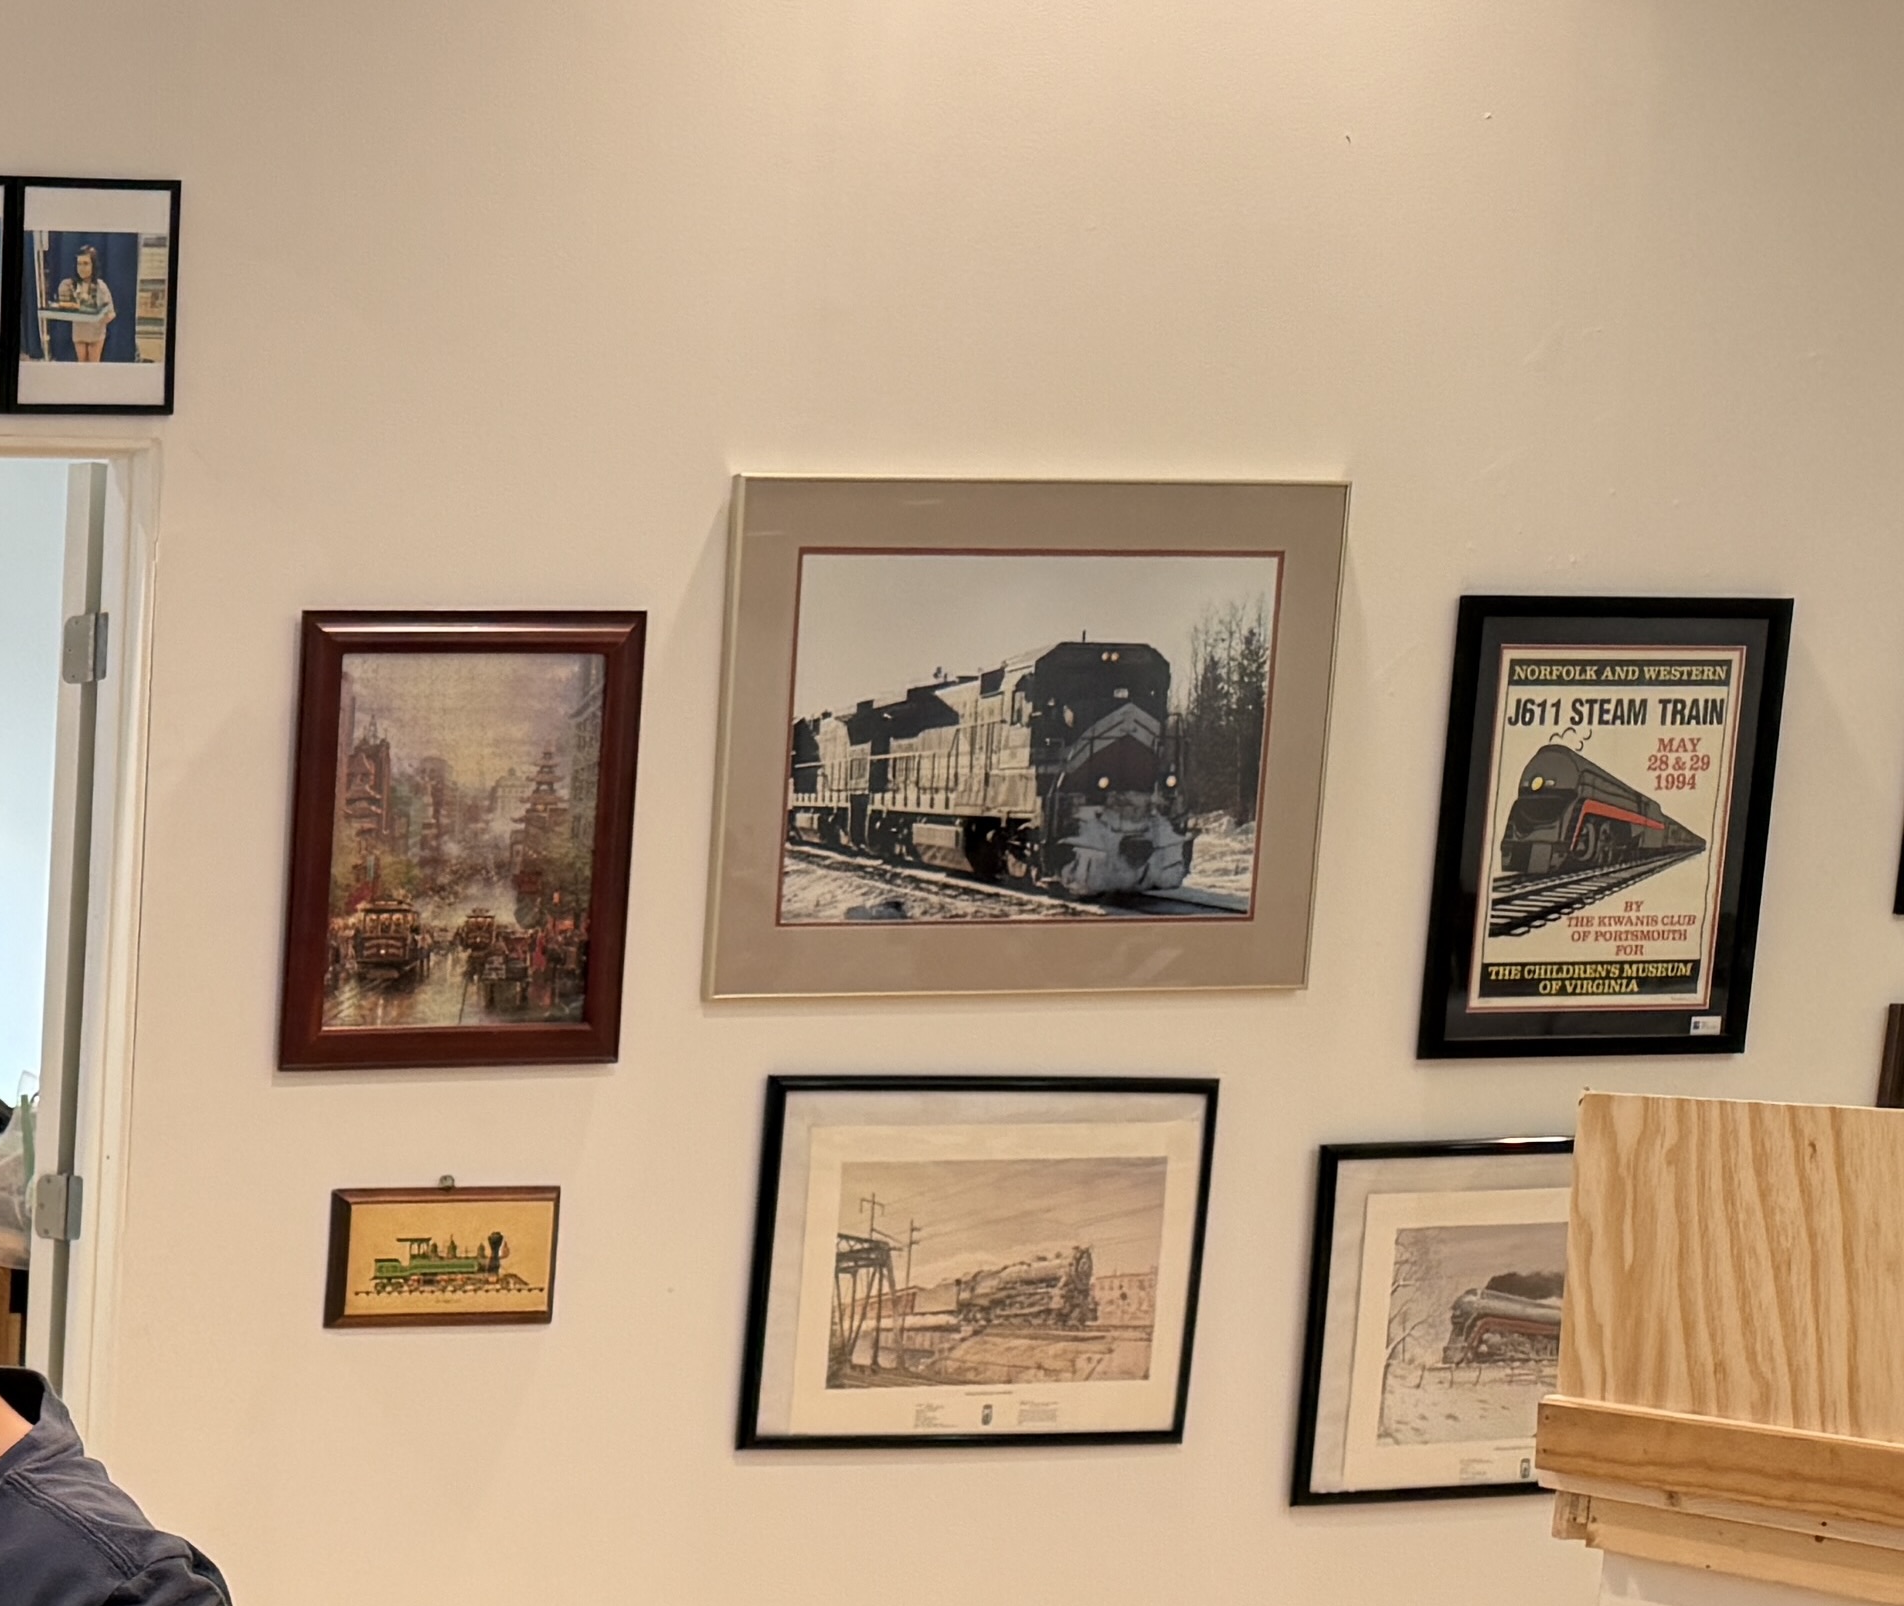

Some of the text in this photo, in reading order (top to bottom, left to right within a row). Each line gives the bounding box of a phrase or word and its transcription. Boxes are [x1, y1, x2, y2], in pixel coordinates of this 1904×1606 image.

[1513, 665, 1728, 680] NORFOLK AND WESTERN
[1507, 698, 1725, 726] J611 STEAM TRAIN
[1657, 737, 1702, 753] MAY
[1647, 754, 1711, 771] 28 & 29
[1654, 773, 1697, 791] 1994
[1624, 901, 1644, 913] BY
[1566, 914, 1697, 928] THE KIWANIS CLUB
[1571, 929, 1687, 942] OF PORTSMOUTH
[1615, 944, 1644, 956] FOR
[1488, 962, 1693, 980] THE CHILDREN'S MUSEUM
[1538, 979, 1639, 994] OF VIRGINIA
